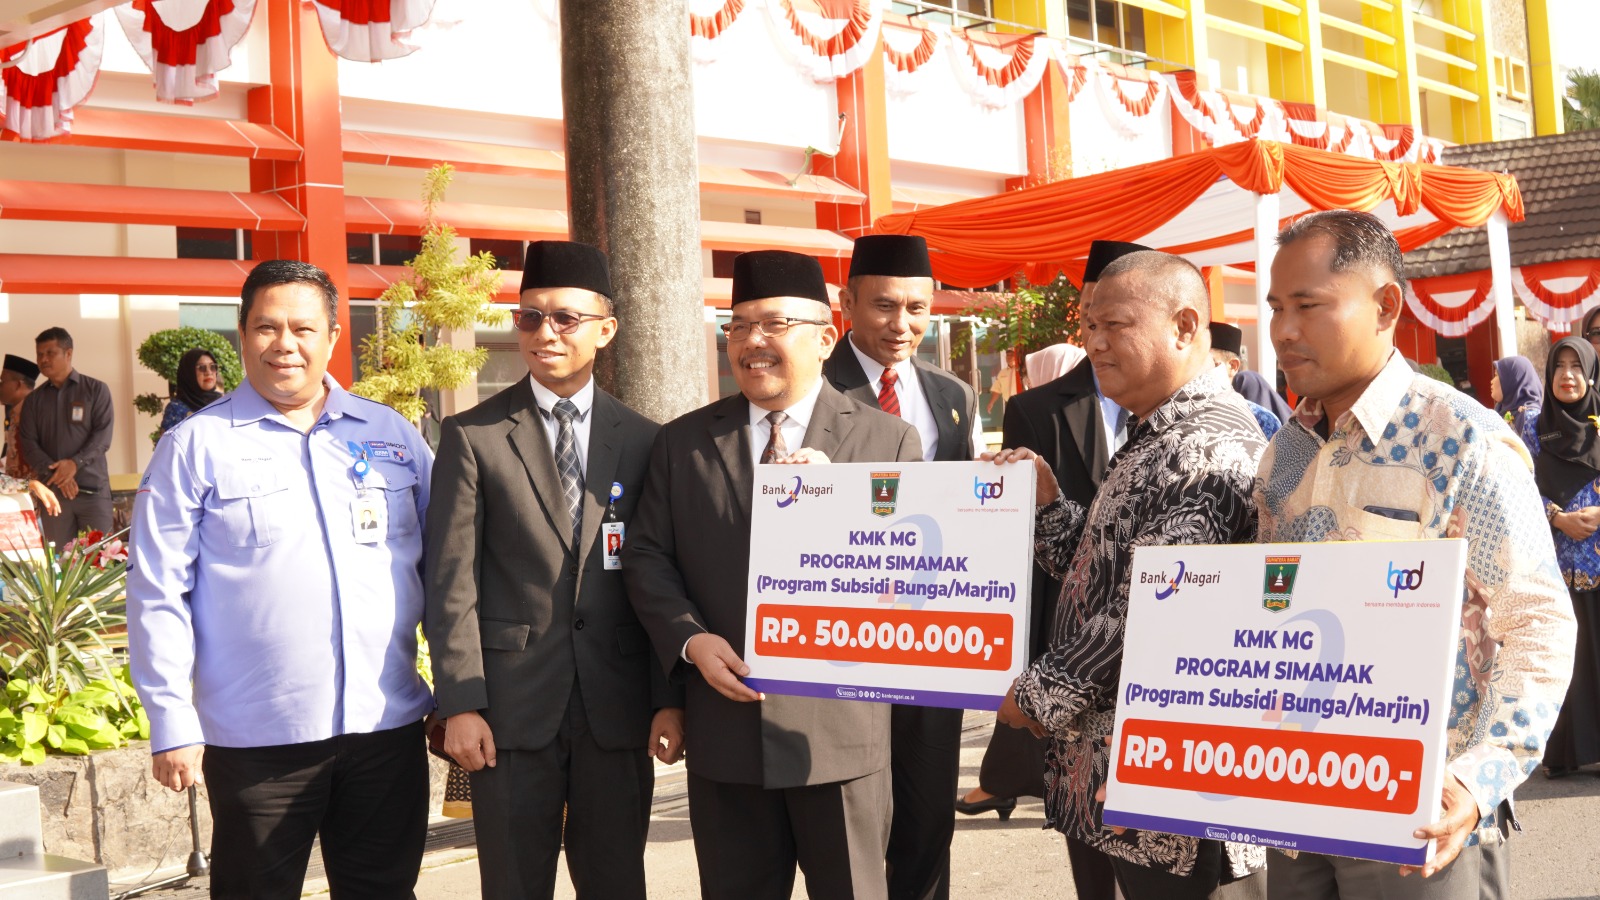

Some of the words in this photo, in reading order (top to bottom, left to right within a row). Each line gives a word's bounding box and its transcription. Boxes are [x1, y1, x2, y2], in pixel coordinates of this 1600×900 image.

[762, 484, 786, 495] Bank
[801, 484, 833, 498] Nagari
[849, 530, 886, 546] KMK
[890, 531, 916, 547] MG
[800, 553, 882, 570] PROGRAM
[885, 555, 968, 572] SIMAMAK
[757, 575, 827, 595] (Program
[831, 577, 890, 595] Subsidi
[894, 579, 1016, 602] Bunga/Marjin)
[1140, 570, 1167, 584] Bank
[1183, 570, 1221, 587] Nagari
[761, 616, 807, 645] RP.
[814, 619, 1005, 661] 50.000.000,-
[1233, 629, 1279, 649] KMK
[1282, 631, 1314, 650] MG
[1175, 656, 1270, 679] PROGRAM
[1274, 661, 1374, 684] SIMAMAK
[1125, 683, 1204, 707] (Program
[1208, 688, 1277, 711] Subsidi
[1281, 693, 1430, 725] Bunga/Marjin)
[1123, 734, 1173, 771] RP.
[1182, 739, 1413, 801] 100.000.000,-
[1257, 837, 1297, 847] banknagari.co.id
